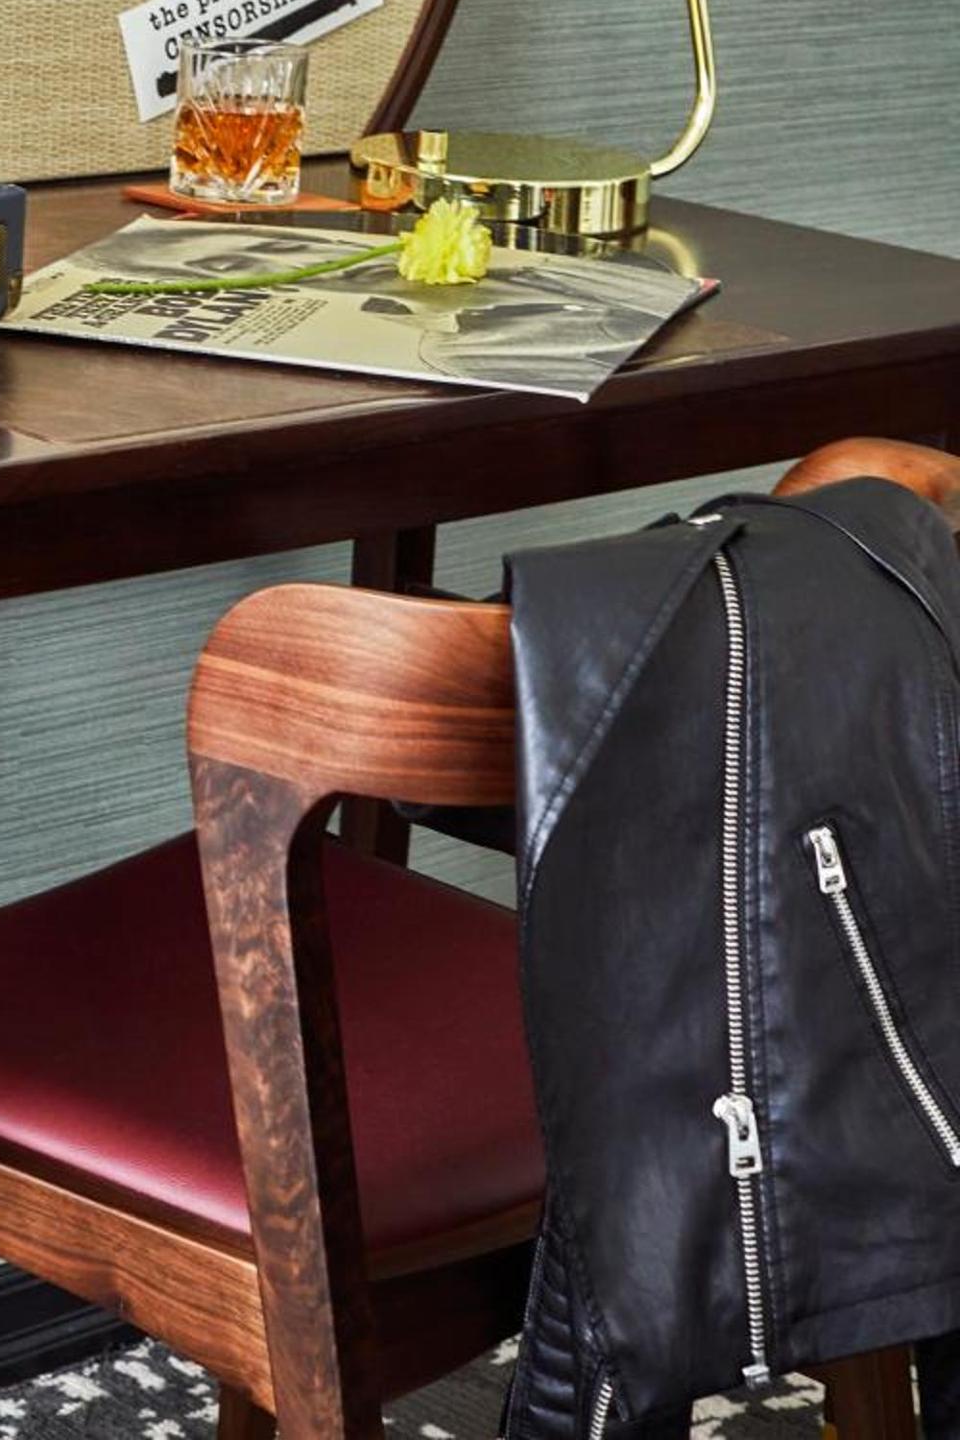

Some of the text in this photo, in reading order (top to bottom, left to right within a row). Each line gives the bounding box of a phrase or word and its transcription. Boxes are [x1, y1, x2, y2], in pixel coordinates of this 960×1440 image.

[149, 1, 189, 31] the
[134, 287, 220, 318] BOB
[152, 289, 272, 343] DYLAN
